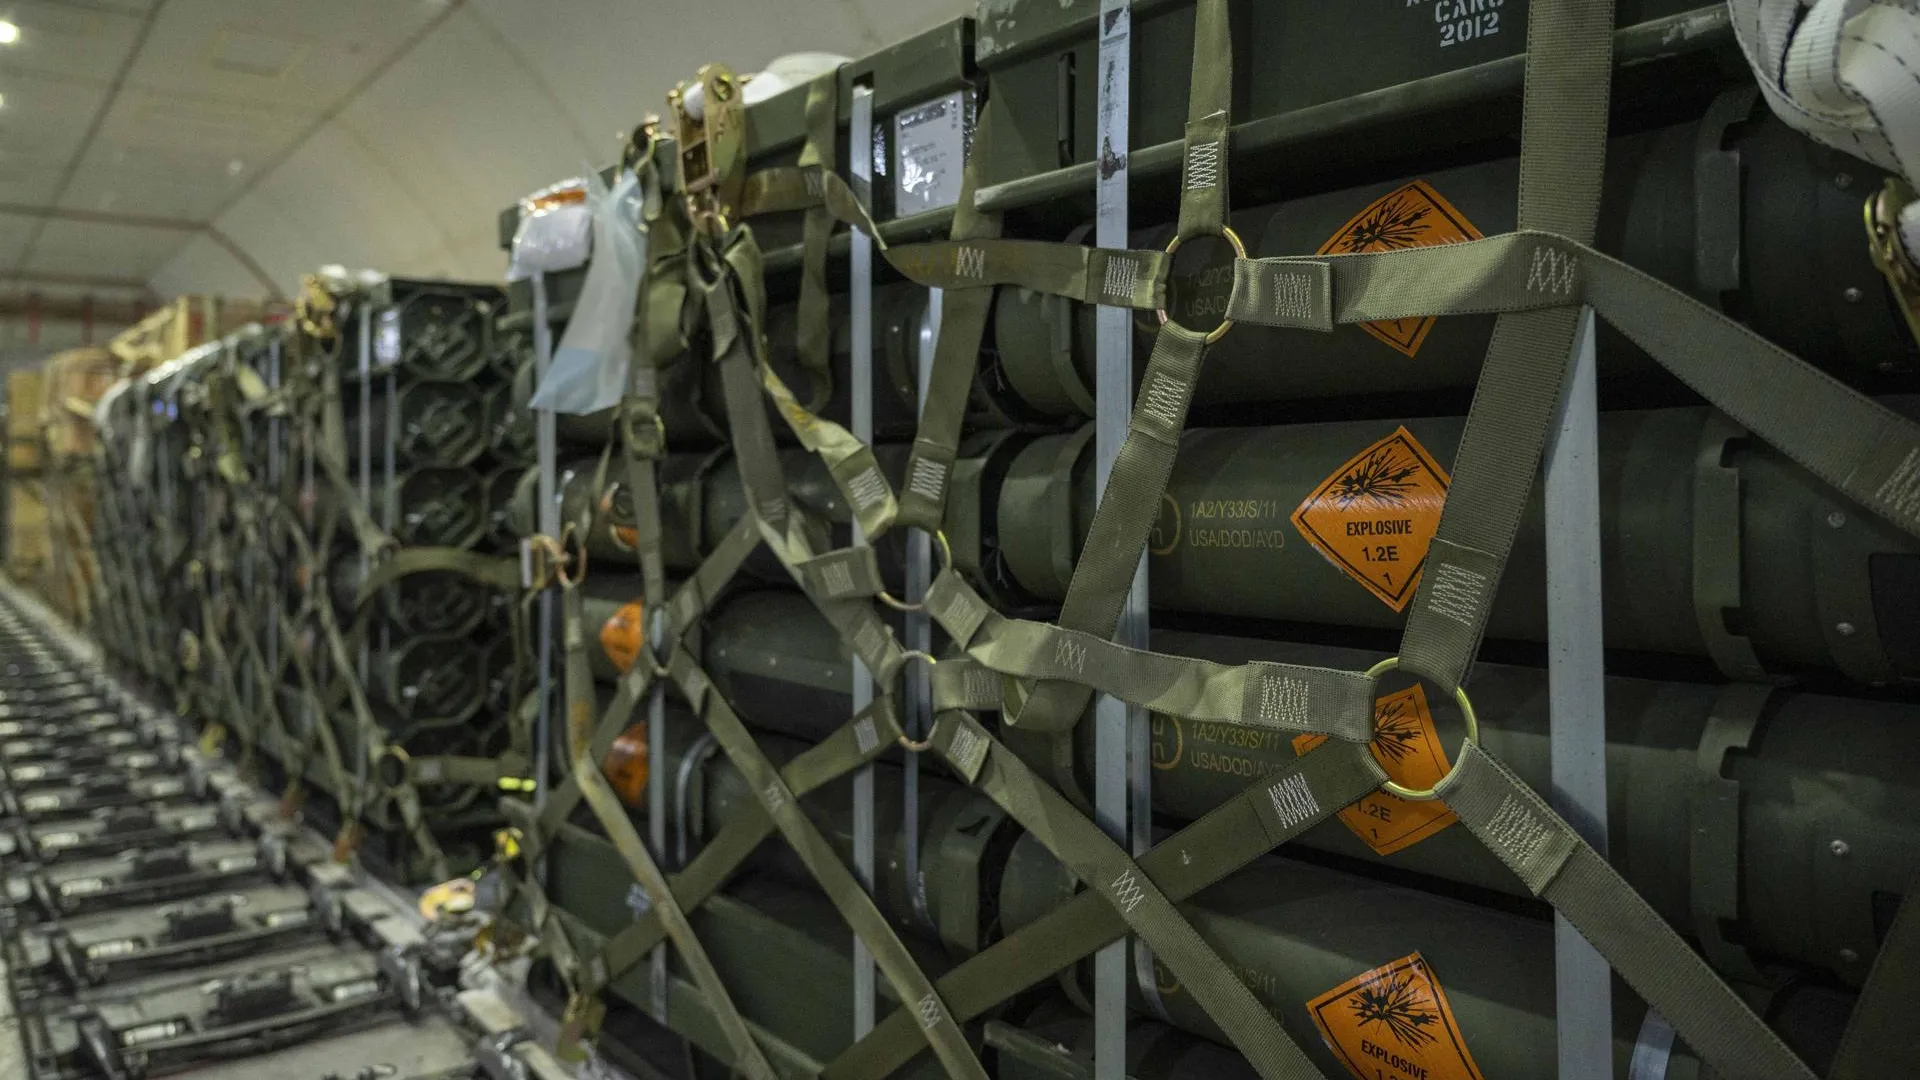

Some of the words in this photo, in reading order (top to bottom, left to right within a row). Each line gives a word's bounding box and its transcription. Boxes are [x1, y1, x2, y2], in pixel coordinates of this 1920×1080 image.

[1439, 11, 1499, 48] 2012
[1185, 295, 1227, 317] USA/D
[1191, 499, 1278, 520] 1A2/Y33/S/11
[1346, 519, 1413, 536] EXPLOSIVE
[1189, 528, 1286, 549] USA/DOD/AYD
[1362, 545, 1401, 563] 1.2E
[1383, 572, 1393, 586] 1
[1190, 722, 1280, 751] 1A2/Y33/S/11
[1357, 799, 1392, 824] 1.2E
[1360, 1039, 1429, 1080] EXPLOSIVE
